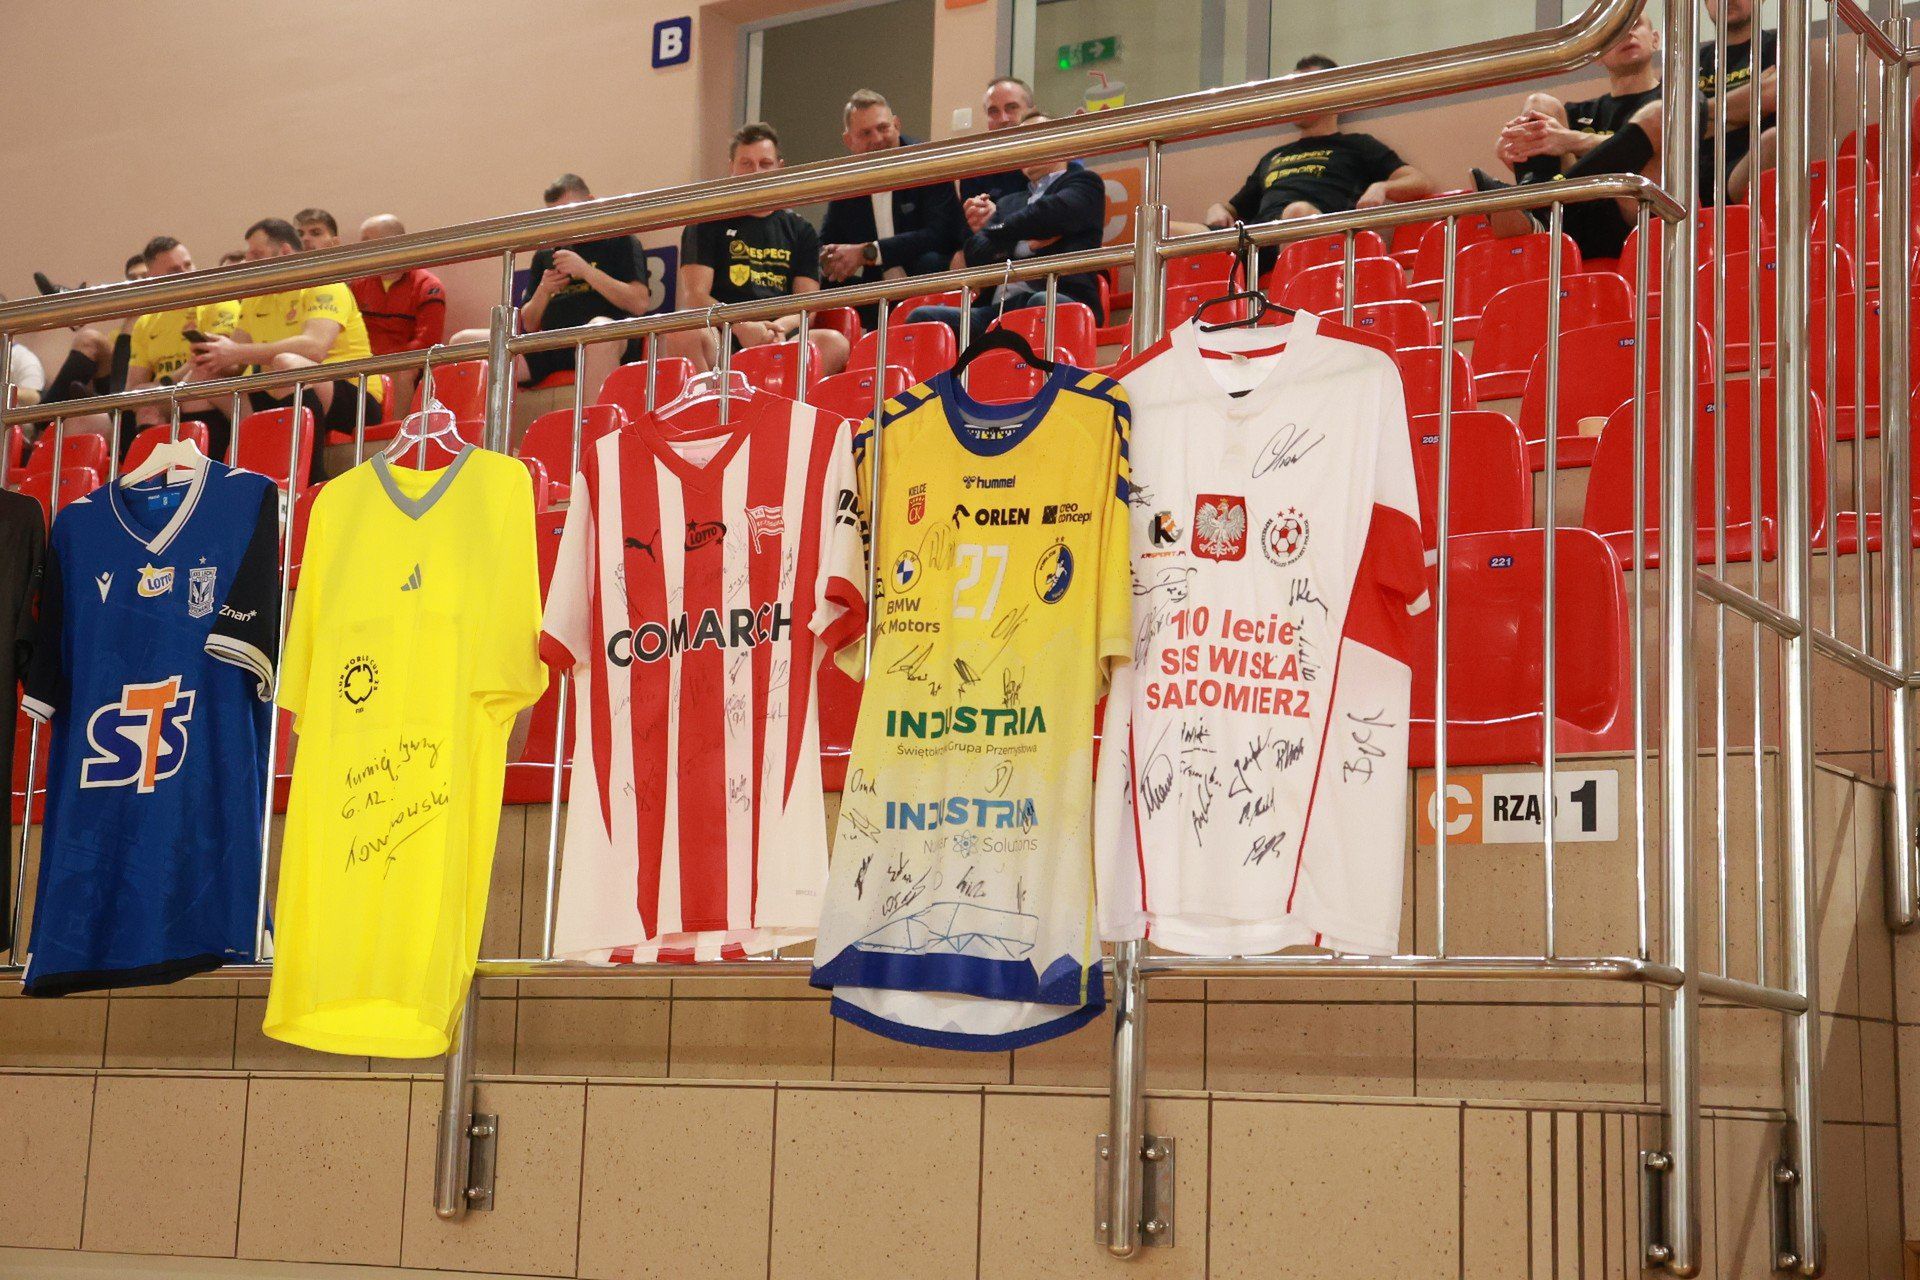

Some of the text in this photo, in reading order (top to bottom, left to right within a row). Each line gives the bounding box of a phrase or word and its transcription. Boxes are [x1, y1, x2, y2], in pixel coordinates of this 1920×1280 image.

[659, 26, 683, 60] B
[909, 483, 927, 496] KIELCE
[977, 475, 1016, 490] hummel
[975, 508, 1030, 526] ORLEN
[690, 527, 718, 544] LOTTO
[1491, 557, 1512, 567] 221
[148, 572, 172, 591] LOTTO
[953, 544, 1009, 621] 27
[887, 597, 921, 615] BMW
[607, 602, 794, 668] COMARCH
[888, 618, 940, 634] Motors
[1171, 606, 1210, 640] 10
[1221, 609, 1294, 646] lecie
[1209, 644, 1299, 682] WISŁA
[80, 675, 196, 793] STS
[948, 741, 982, 754] Grupa
[1428, 780, 1597, 836] C RZĄ 1
